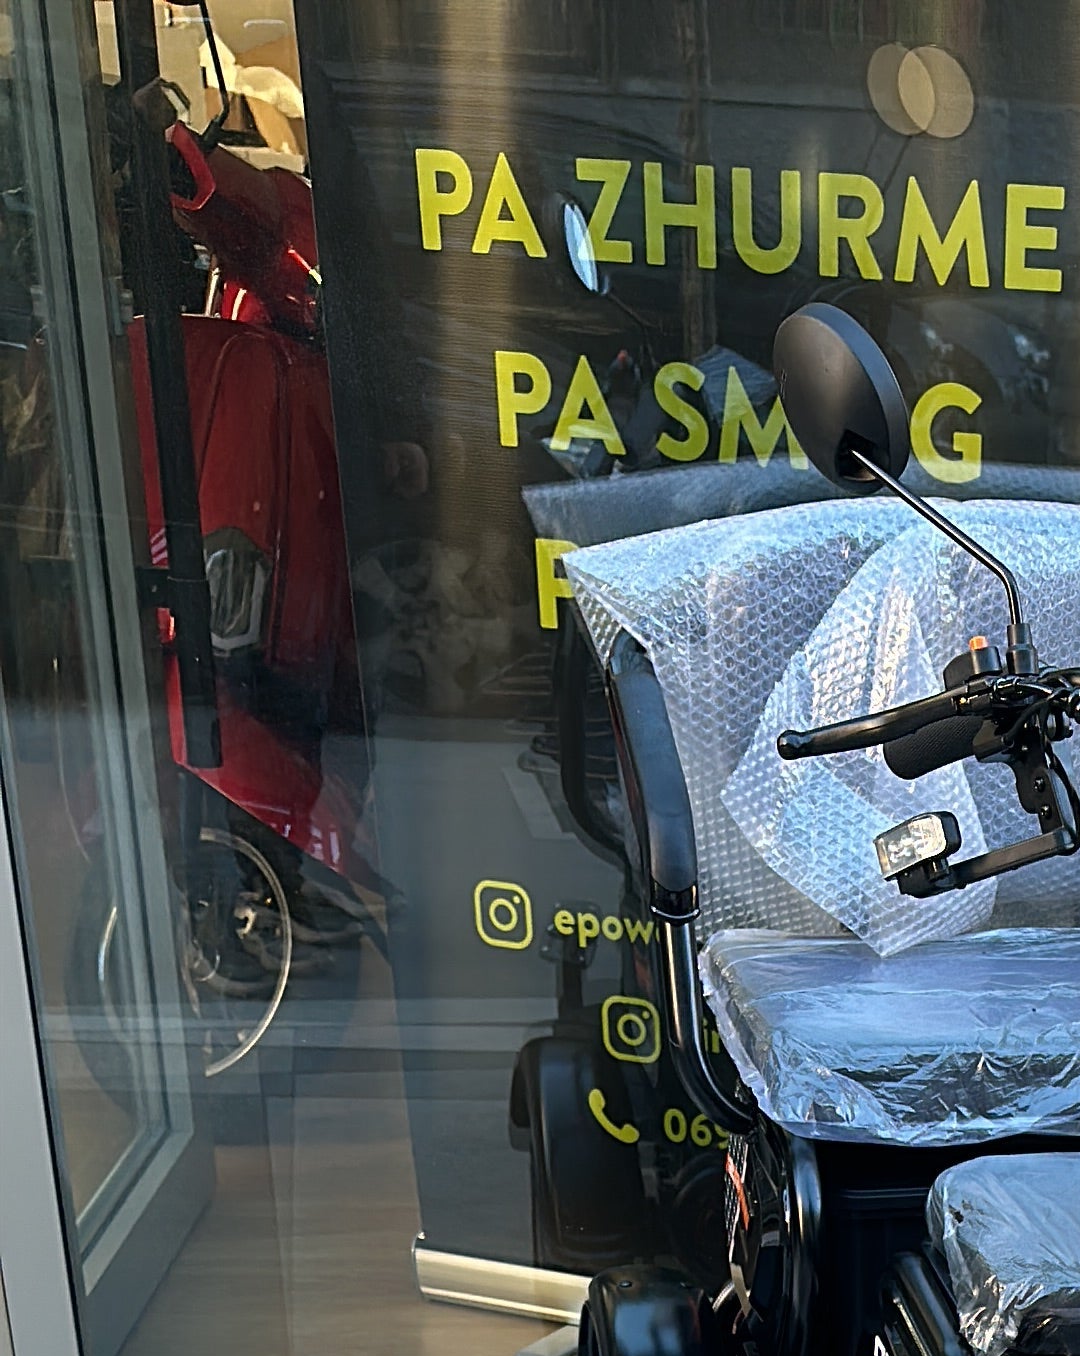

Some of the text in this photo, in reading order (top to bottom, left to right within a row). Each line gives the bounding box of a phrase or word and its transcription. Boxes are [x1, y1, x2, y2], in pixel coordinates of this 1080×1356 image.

[415, 148, 1065, 292] PA ZHURME
[494, 350, 983, 484] PA SMG
[535, 538, 578, 630] P
[553, 910, 660, 948] epow
